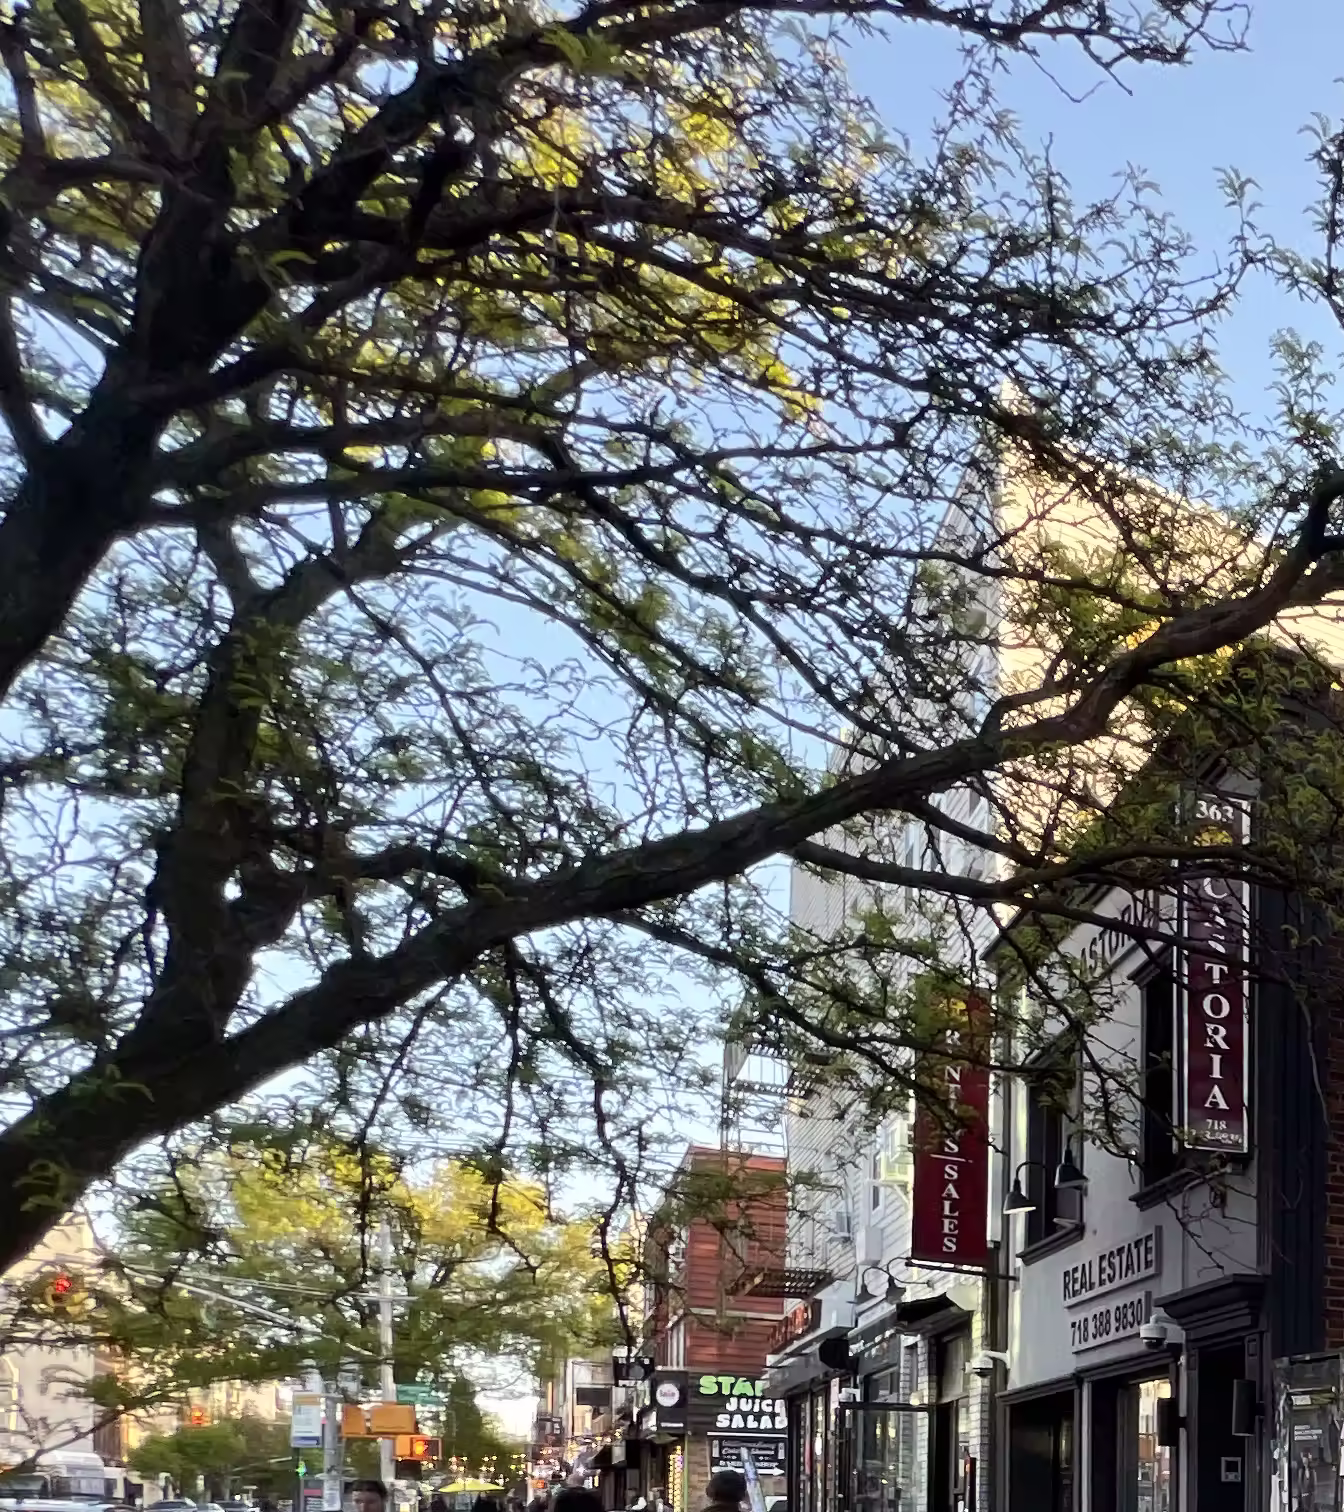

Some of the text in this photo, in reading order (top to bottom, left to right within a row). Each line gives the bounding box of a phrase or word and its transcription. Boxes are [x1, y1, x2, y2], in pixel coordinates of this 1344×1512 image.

[1195, 800, 1235, 823] 363
[940, 1163, 960, 1253] SALES
[1063, 1233, 1153, 1301] REAL ESTATE
[1071, 1298, 1143, 1346] 718 388 9830
